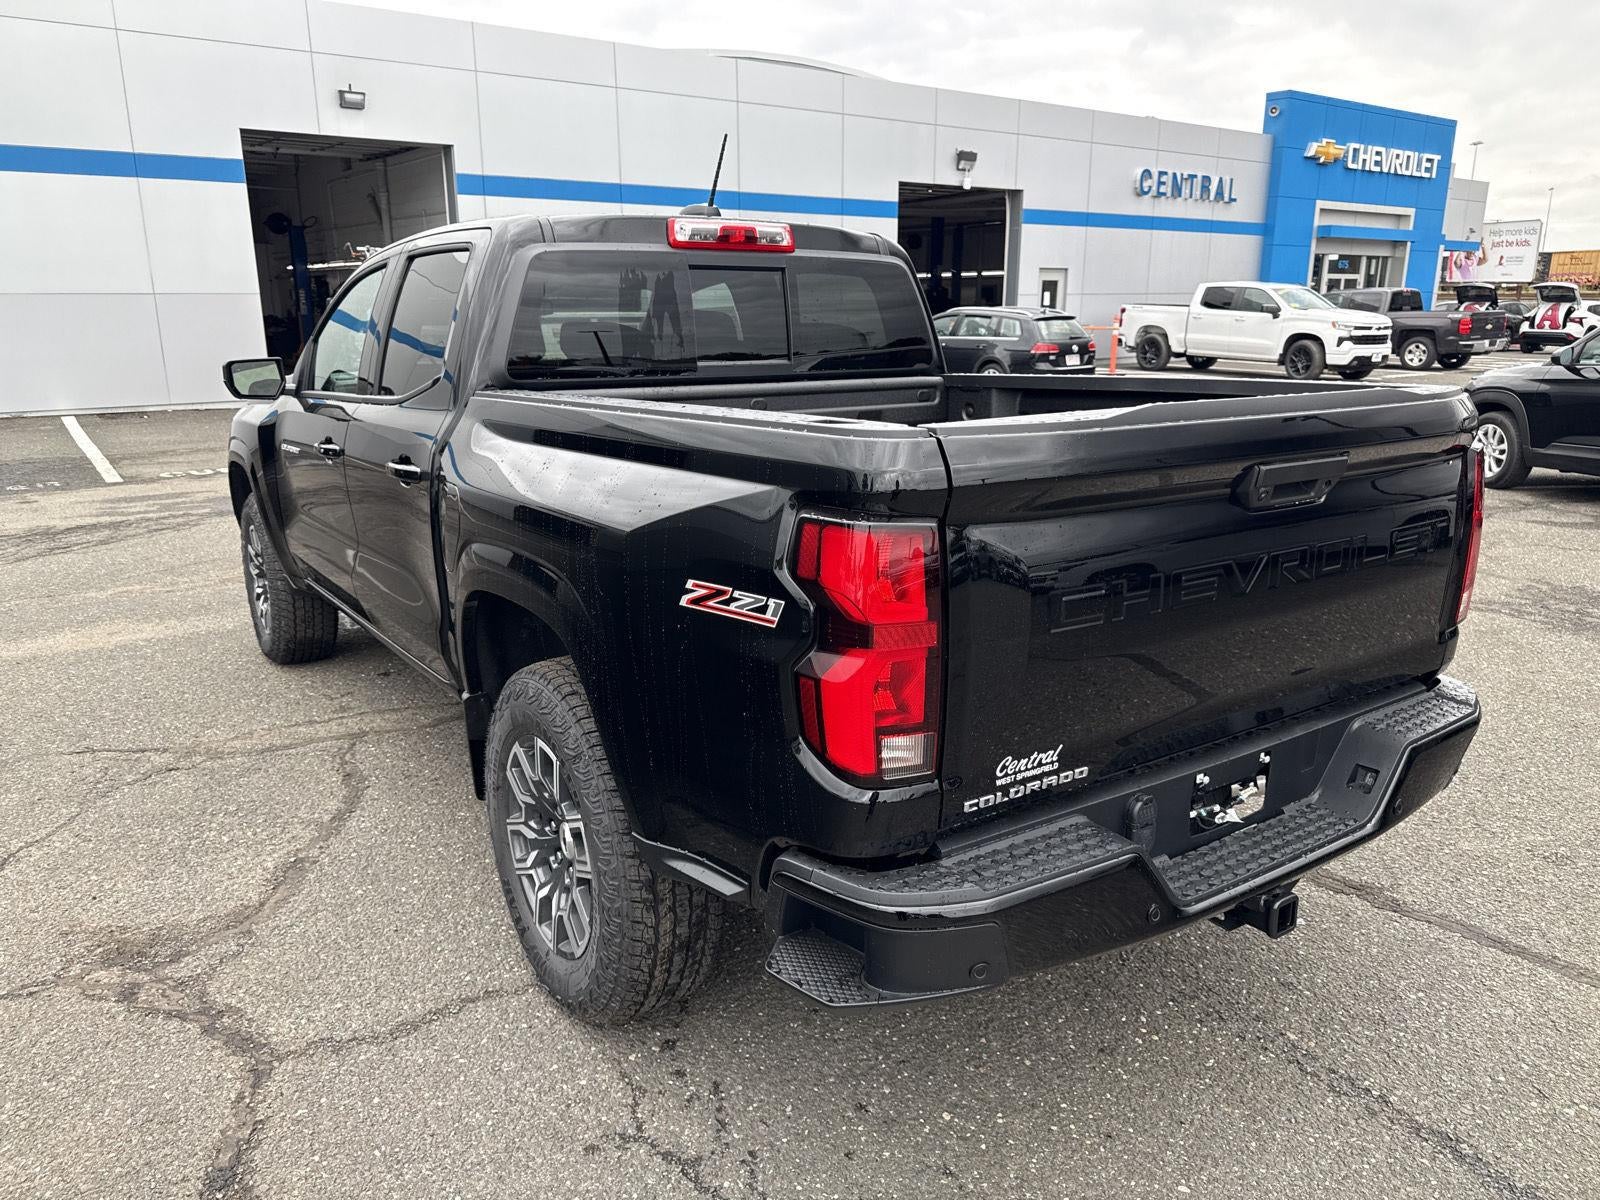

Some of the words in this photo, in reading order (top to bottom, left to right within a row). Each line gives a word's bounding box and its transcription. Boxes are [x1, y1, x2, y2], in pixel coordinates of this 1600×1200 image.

[1345, 142, 1441, 179] CHEVROLET
[1137, 168, 1238, 203] CENTRAL
[1489, 228, 1504, 238] Help
[1505, 228, 1523, 236] more
[1524, 226, 1538, 236] kids
[1490, 239, 1504, 250] just
[1505, 238, 1515, 248] be
[1515, 237, 1532, 248] kids.
[1050, 516, 1449, 634] CHEVROLET
[679, 579, 785, 628] Z71
[996, 744, 1063, 777] Central
[996, 776, 1016, 787] WEST
[1016, 762, 1059, 781] SPRINGFIELD
[963, 766, 1089, 813] COLORADO
